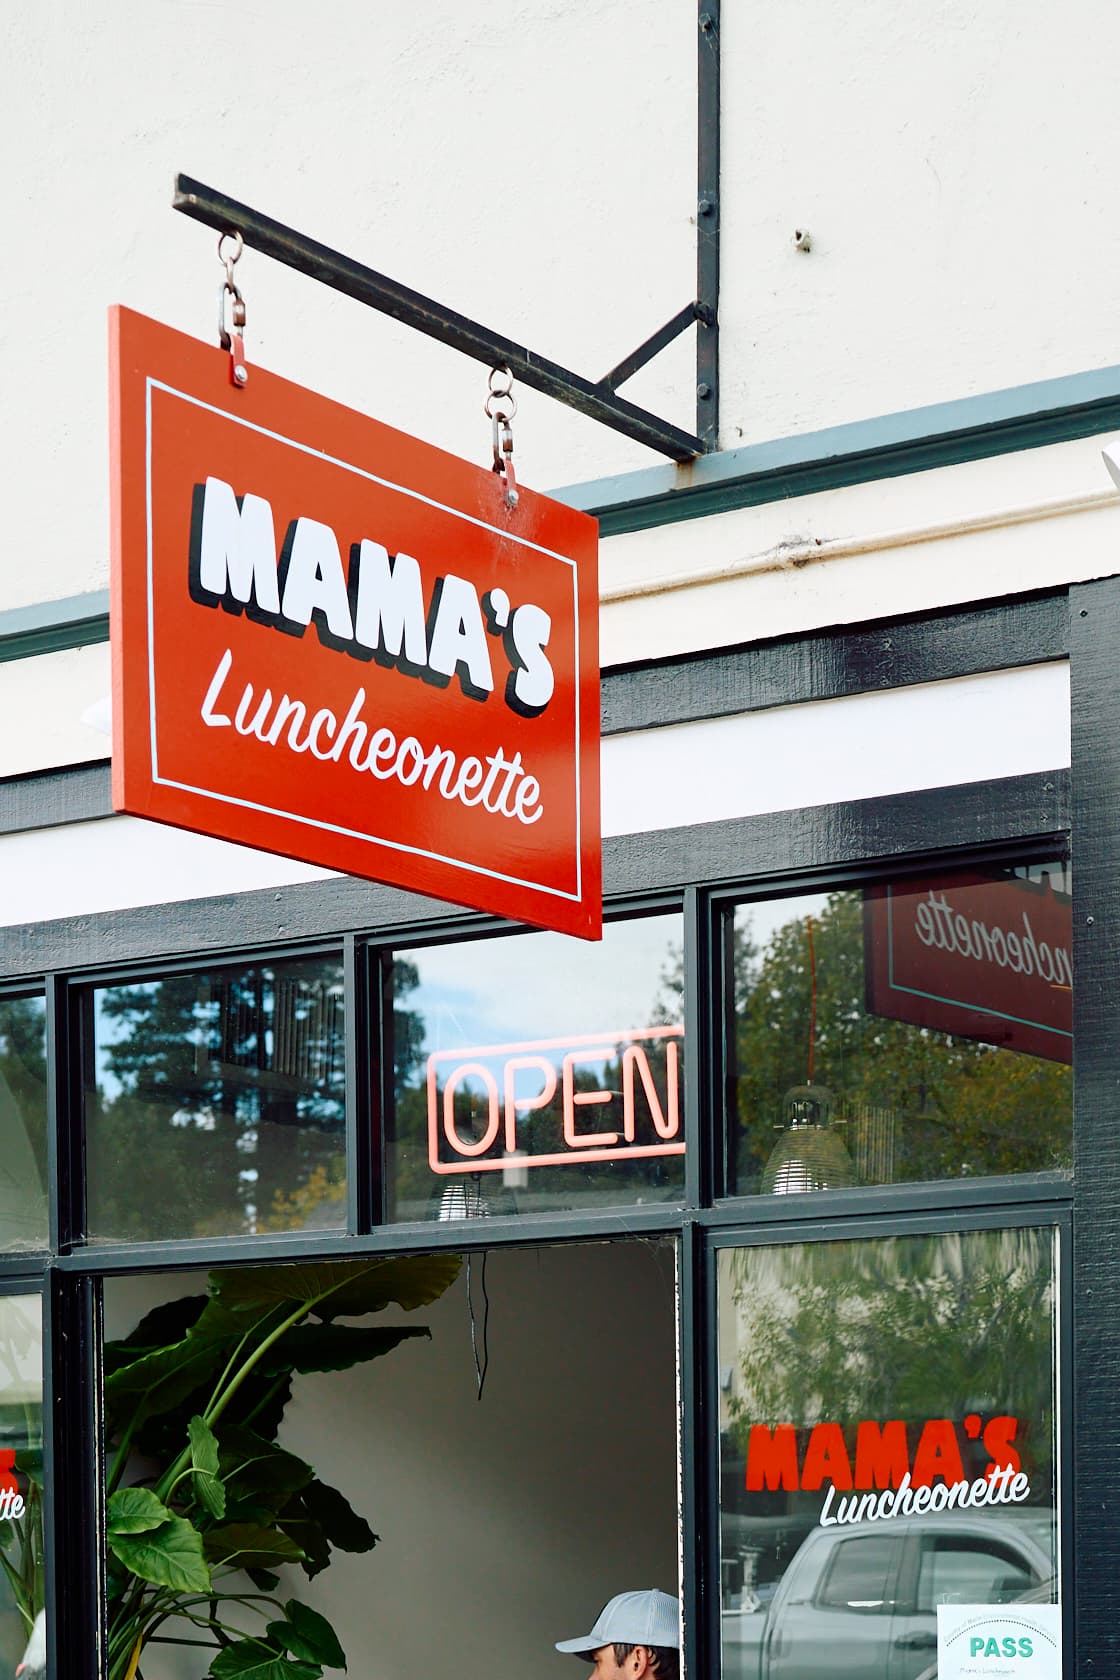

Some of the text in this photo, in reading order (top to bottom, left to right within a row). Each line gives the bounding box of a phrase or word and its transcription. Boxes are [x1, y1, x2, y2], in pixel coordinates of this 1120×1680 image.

[189, 476, 555, 719] MAMA'S
[200, 649, 544, 825] Luncheonette
[443, 1040, 679, 1157] OPEN
[745, 1414, 1022, 1492] MAMA'S
[819, 1462, 1031, 1528] Luncheonette
[970, 1637, 1034, 1658] PASS
